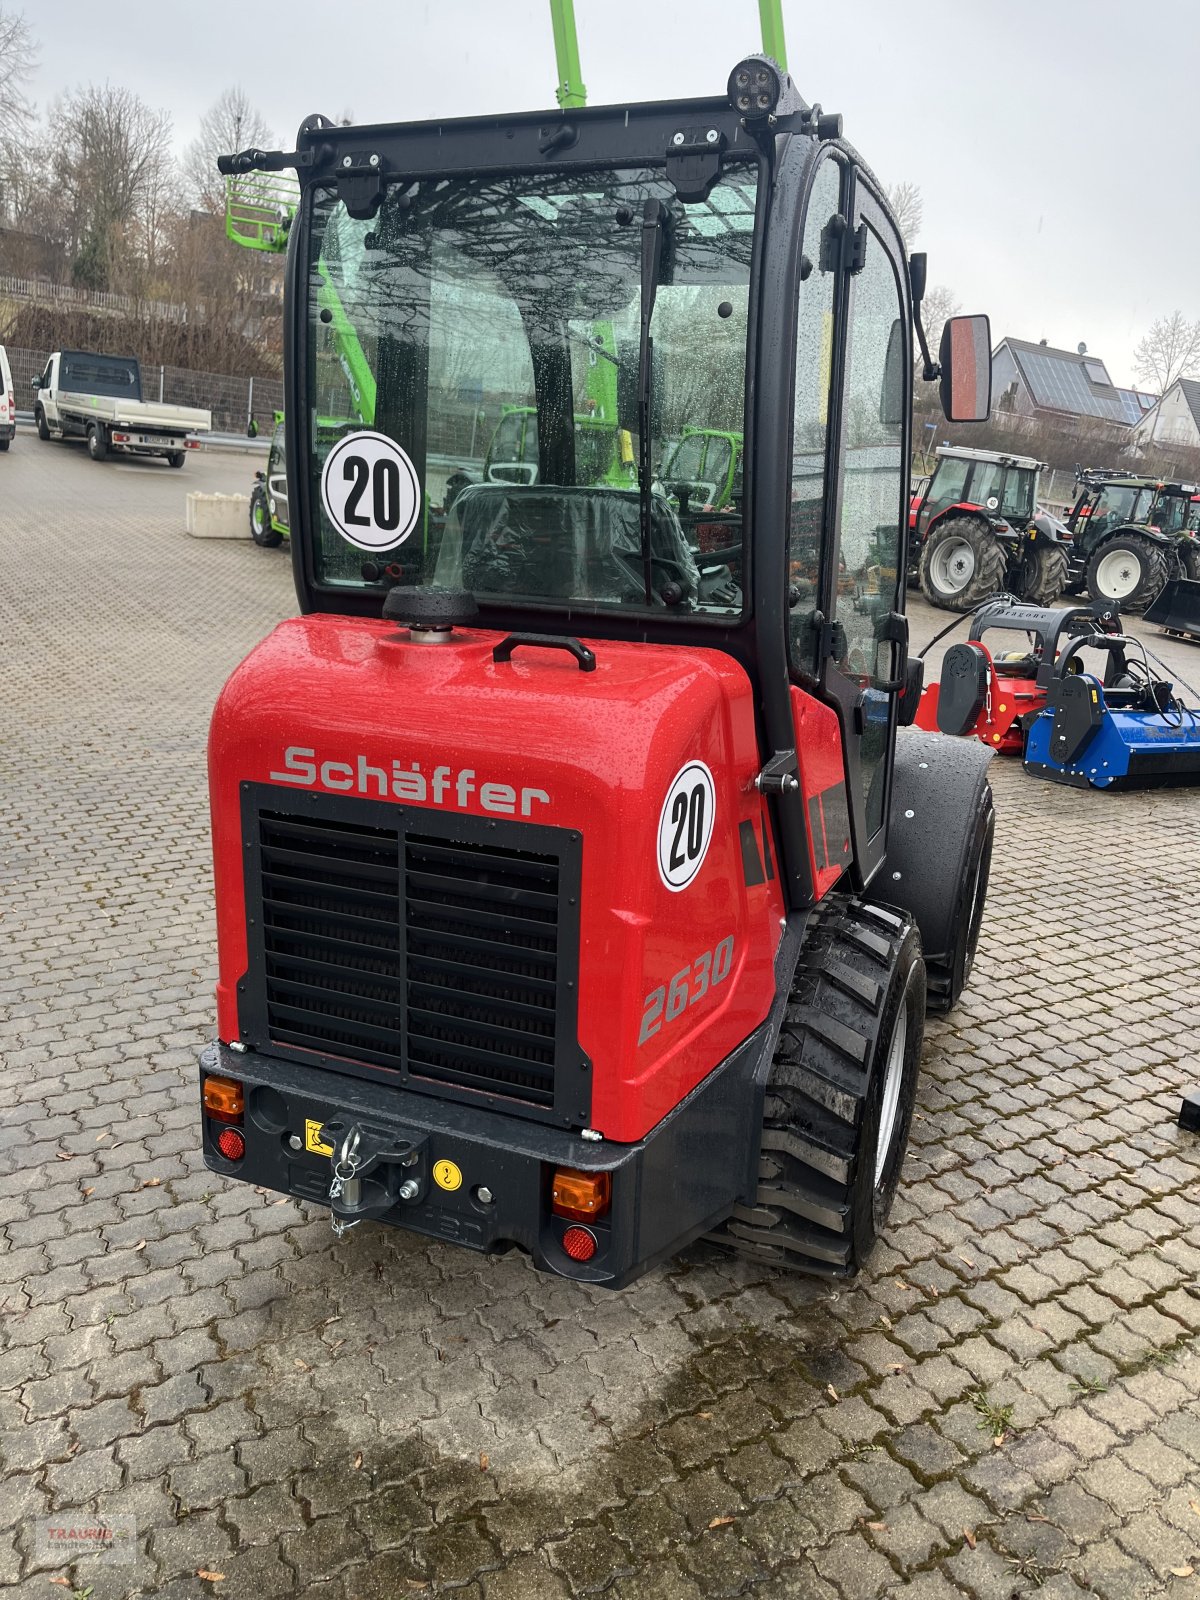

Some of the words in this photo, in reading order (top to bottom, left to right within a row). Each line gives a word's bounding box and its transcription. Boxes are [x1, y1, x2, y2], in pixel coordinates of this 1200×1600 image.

[343, 455, 400, 531] 20
[269, 746, 550, 816] Schäffer
[669, 783, 706, 873] 20
[637, 934, 734, 1047] 2630
